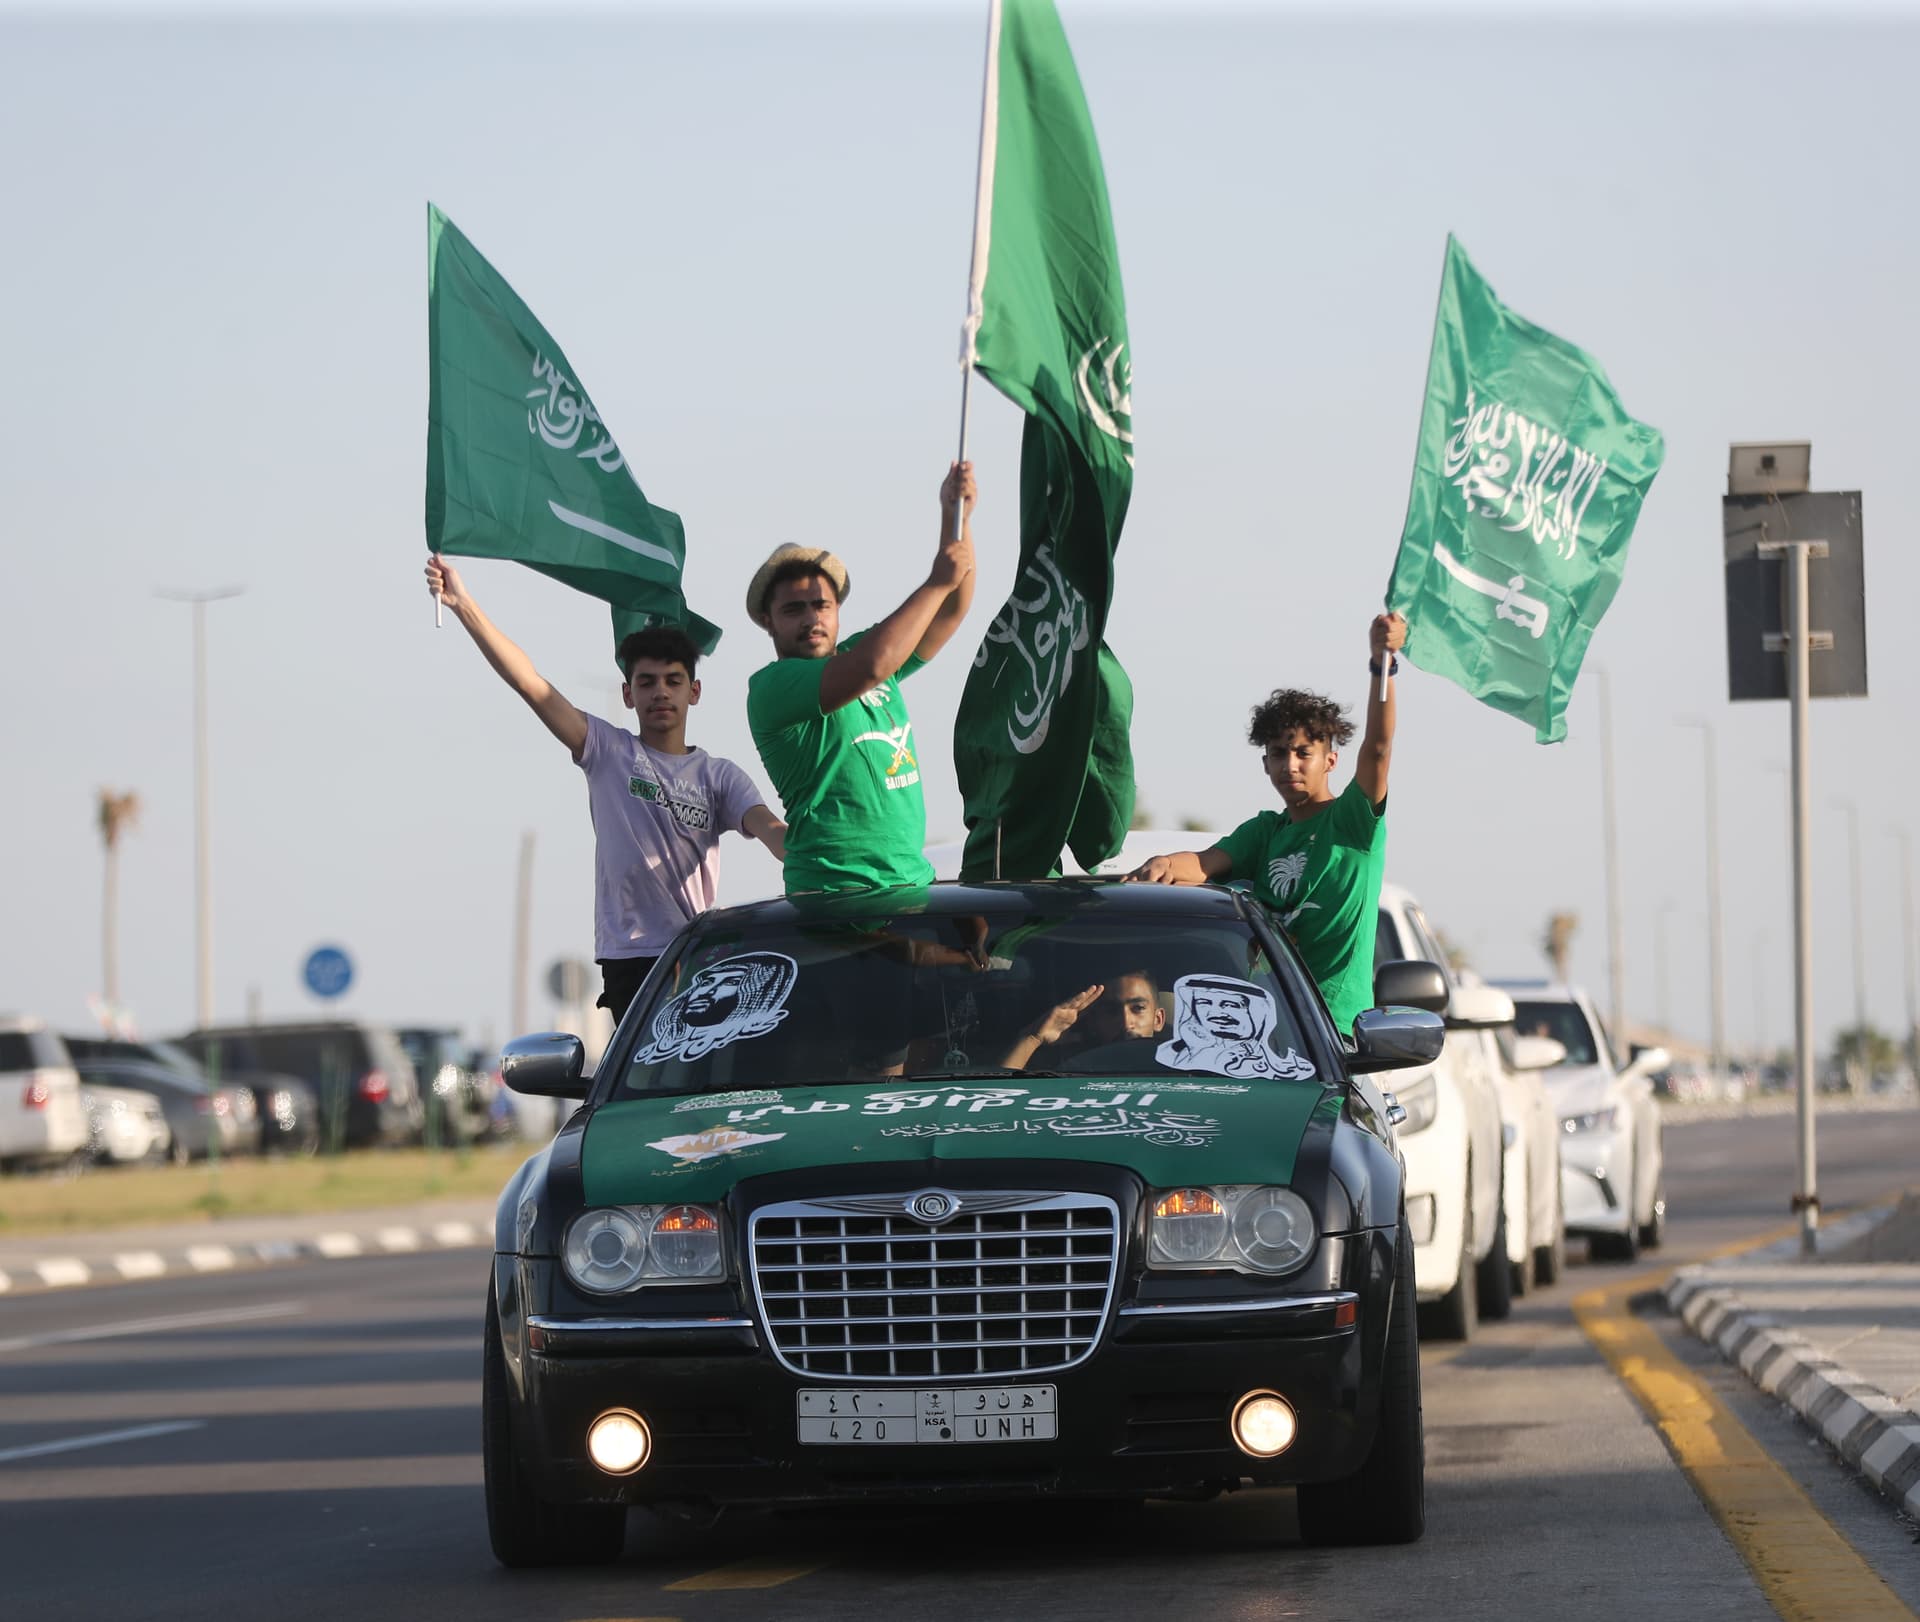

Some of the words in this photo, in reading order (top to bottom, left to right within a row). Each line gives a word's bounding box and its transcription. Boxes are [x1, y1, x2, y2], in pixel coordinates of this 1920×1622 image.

[967, 1093, 1158, 1112] اليوم
[829, 1420, 886, 1440] 420
[924, 1418, 947, 1426] KSA
[975, 1417, 1035, 1438] UNH
